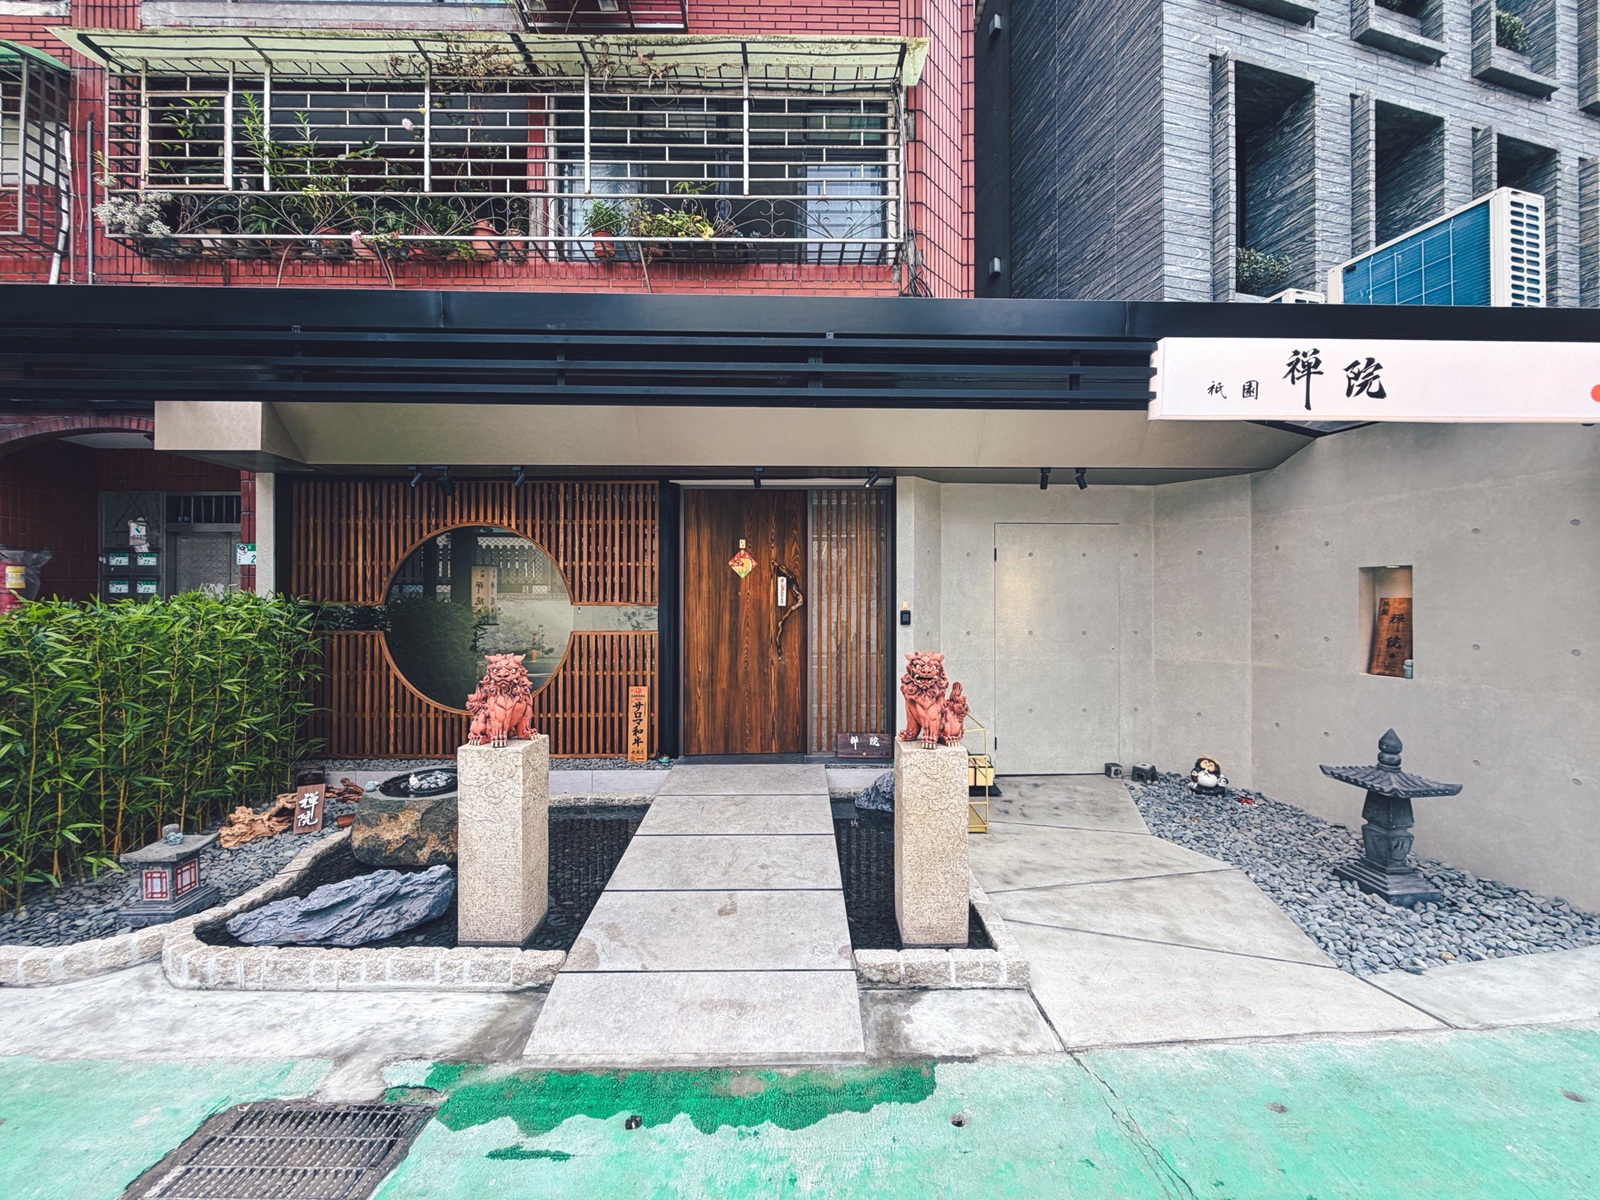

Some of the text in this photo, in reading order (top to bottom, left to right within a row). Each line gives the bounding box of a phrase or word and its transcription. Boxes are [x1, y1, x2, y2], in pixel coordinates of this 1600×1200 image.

[632, 701, 644, 747] サロマ和牛
